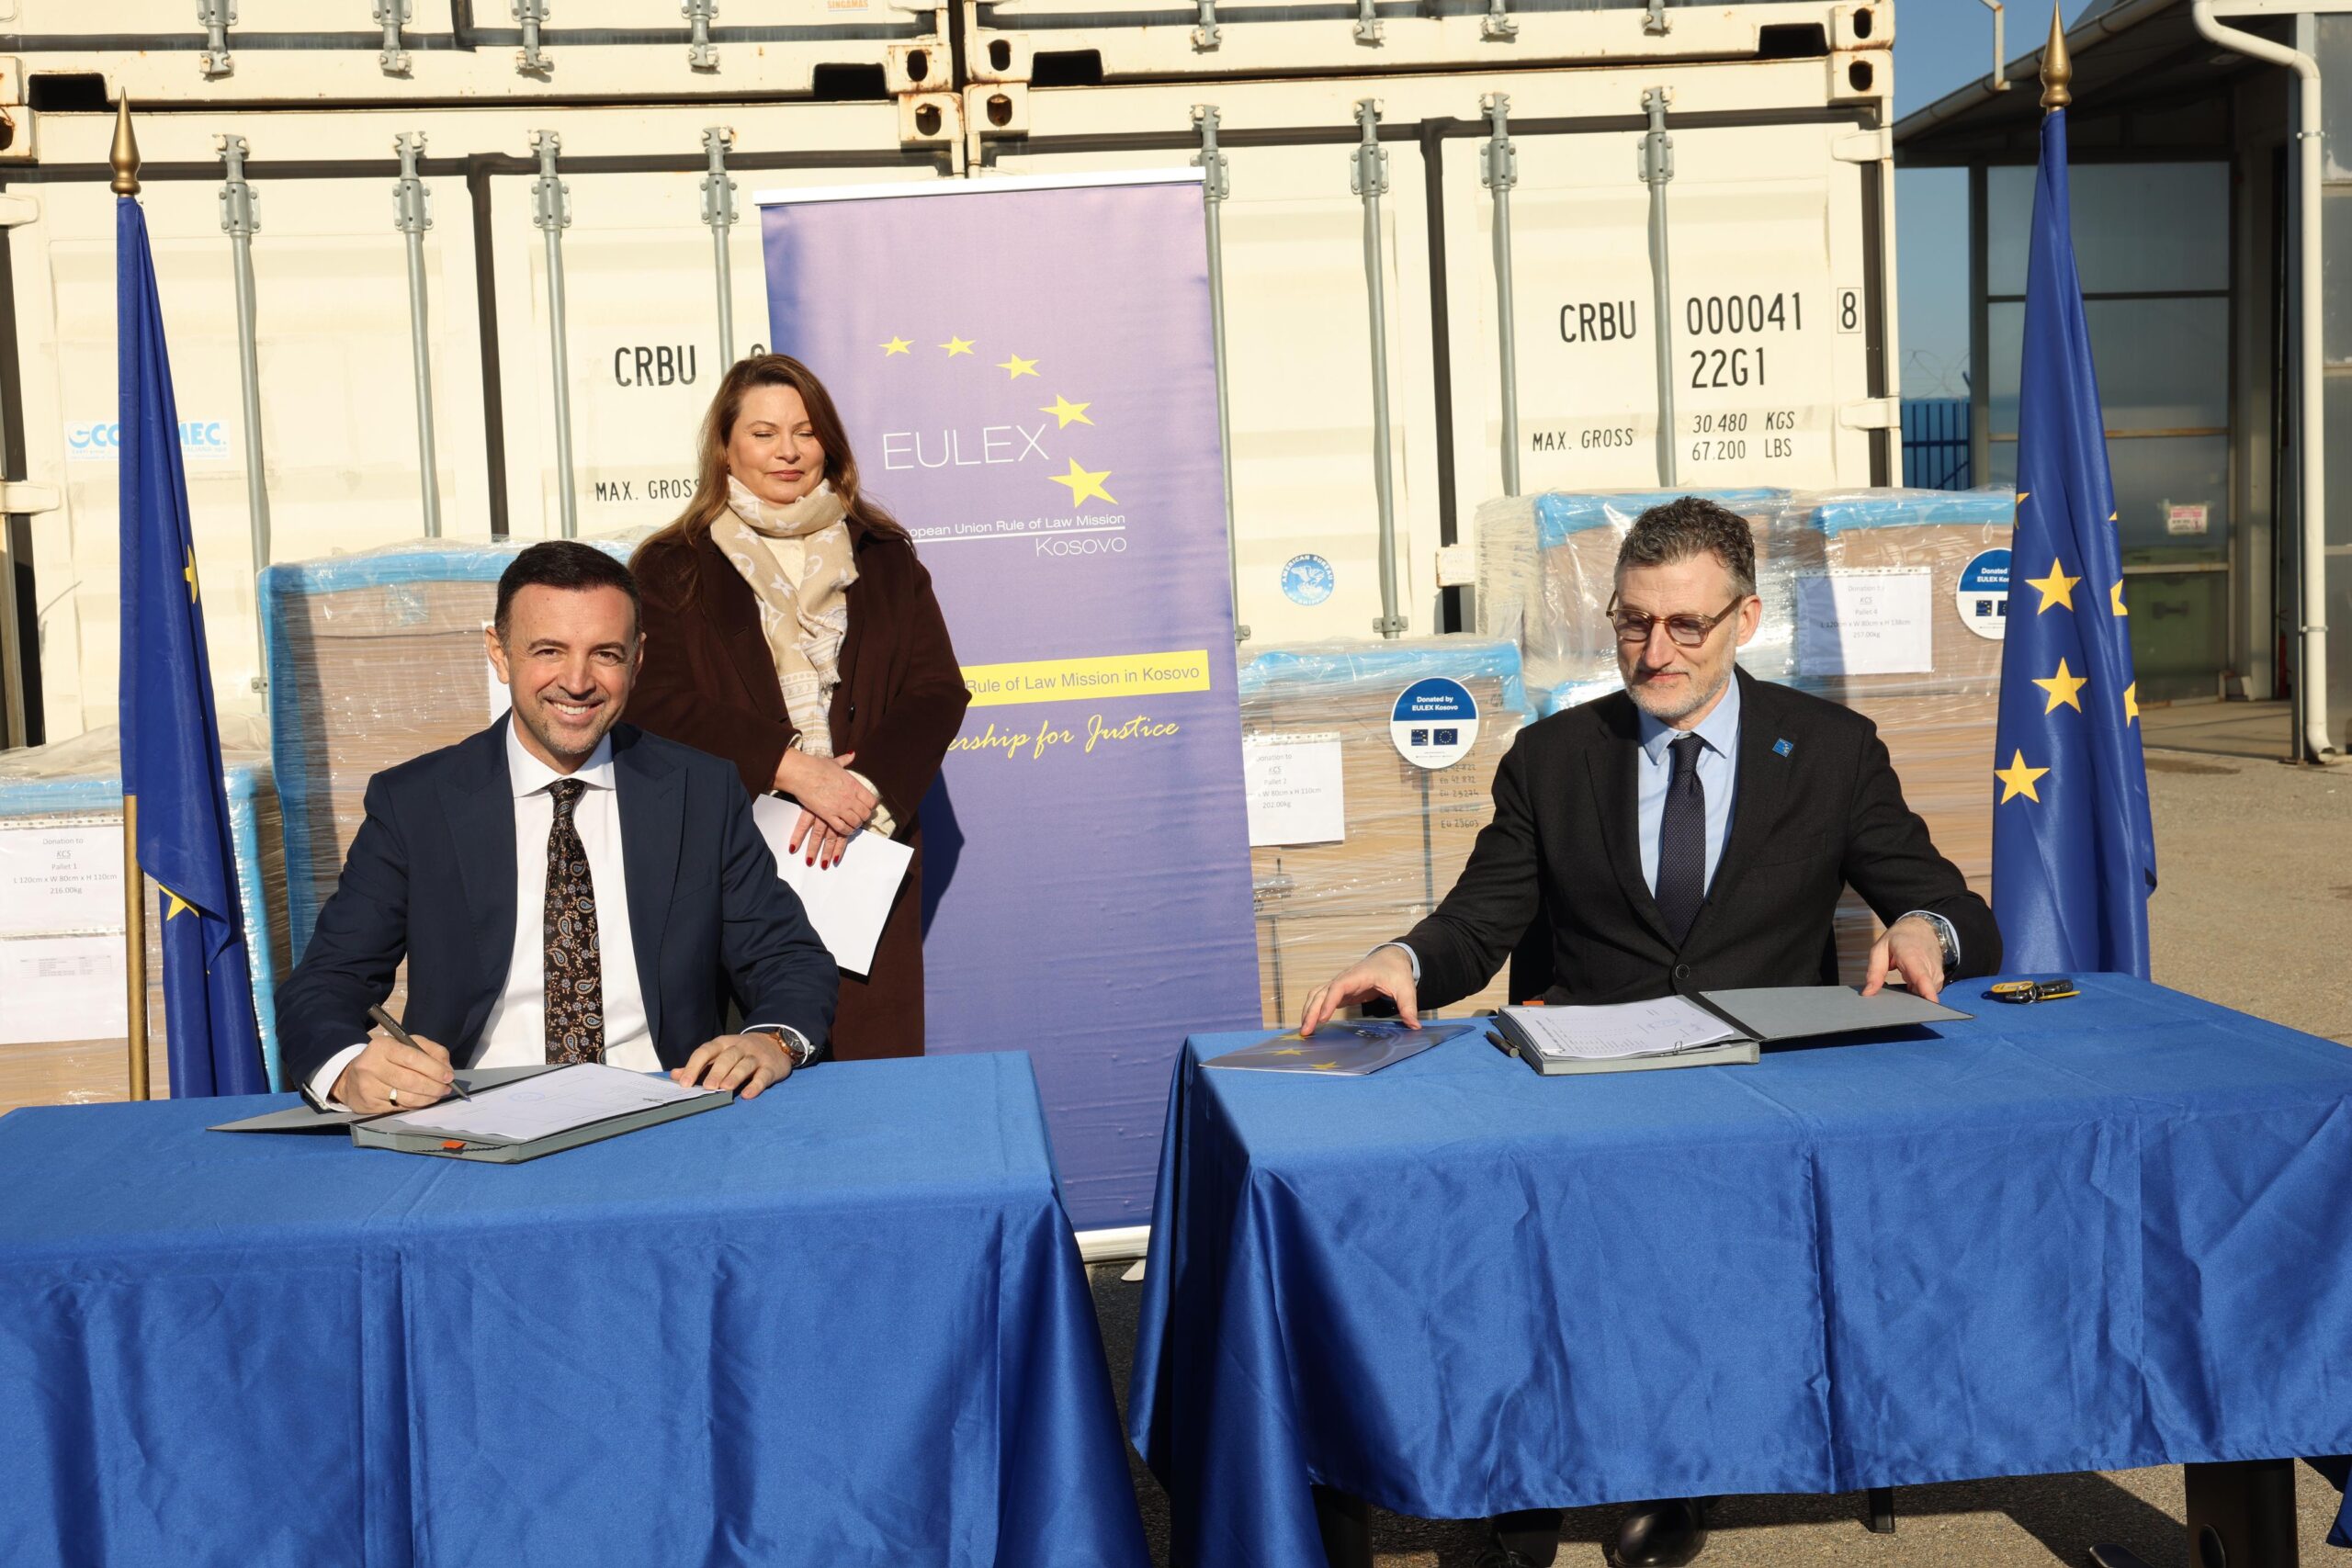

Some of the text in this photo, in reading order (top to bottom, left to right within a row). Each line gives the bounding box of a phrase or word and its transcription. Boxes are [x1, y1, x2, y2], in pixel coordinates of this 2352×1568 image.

[1560, 291, 1857, 343] CRBU 000041 8
[615, 344, 696, 387] CRBU
[1690, 347, 1764, 389] 22G1
[1532, 411, 1795, 452] MAX. GROSS 30.480 KGS
[883, 423, 1049, 469] EULEX
[1692, 438, 1792, 461] 67.200 LBS
[595, 481, 639, 502] MAX.
[906, 513, 1125, 538] ropean Union Rule of Law Mission
[1035, 536, 1127, 557] Kosovo
[1282, 555, 1310, 582] AMERICAN
[1313, 556, 1333, 581] BUREAU
[966, 665, 1200, 694] Rule of Law Mission in Kosovo
[947, 714, 1180, 760] ership for Justice
[56, 850, 71, 858] KCS
